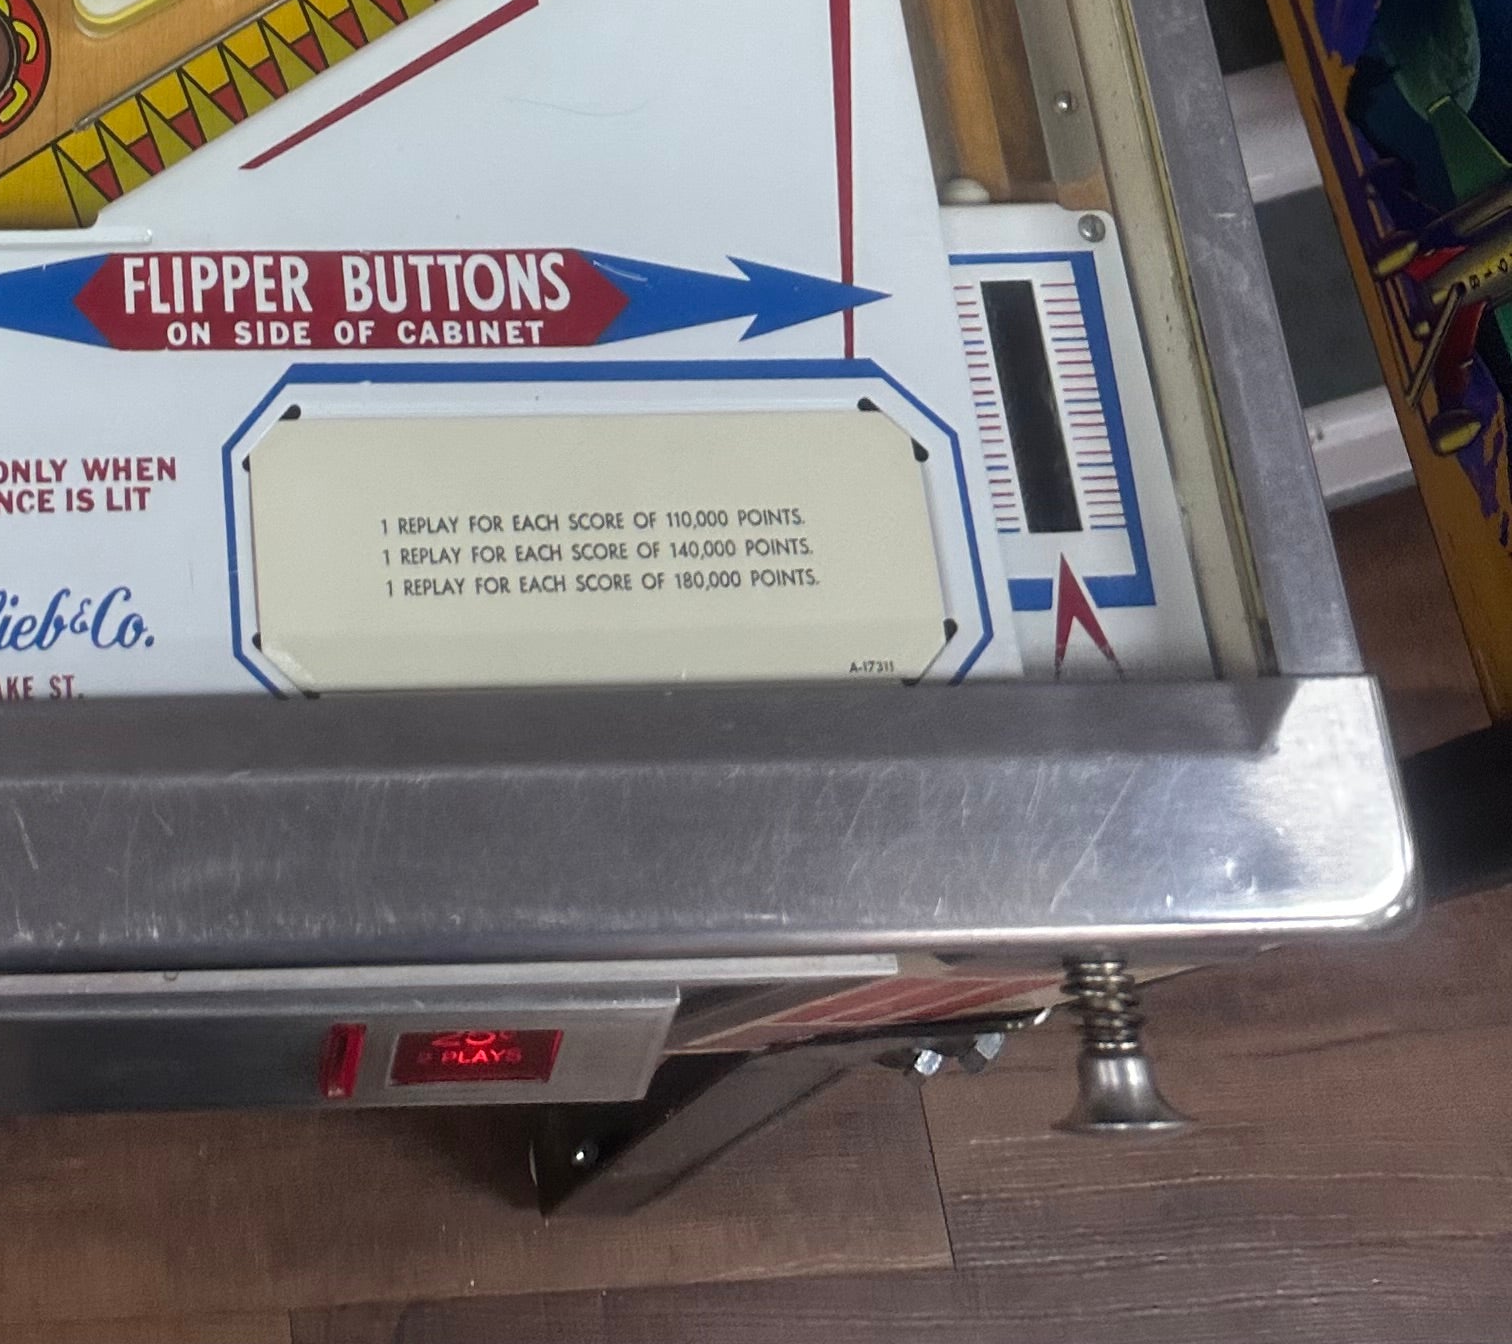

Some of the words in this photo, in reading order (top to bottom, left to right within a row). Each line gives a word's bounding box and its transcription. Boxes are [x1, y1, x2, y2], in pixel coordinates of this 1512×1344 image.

[122, 255, 313, 315] FLIPPER
[342, 252, 572, 312] BUTTONS
[166, 321, 211, 347] ON
[234, 320, 312, 347] SIDE
[334, 320, 376, 346] OF
[397, 319, 545, 346] CABINET
[81, 456, 176, 482] WHEN
[65, 487, 95, 513] IS
[105, 486, 151, 512] LIT
[381, 519, 388, 535] 1
[398, 516, 459, 534] REPLAY
[469, 514, 504, 533] FOR
[512, 513, 560, 531] EACH
[568, 512, 625, 530] SCORE
[633, 512, 656, 529] OF
[665, 509, 729, 530] 110,000
[737, 507, 805, 526] POINTS.
[382, 549, 390, 565] 1
[400, 546, 461, 565] REPLAY
[471, 545, 507, 563] FOR
[515, 544, 563, 562] EACH
[571, 542, 628, 561] SCORE
[636, 541, 660, 559] OF
[669, 539, 736, 560] 140,000
[745, 537, 814, 556] POINTS.
[386, 580, 393, 596] 1
[403, 577, 465, 596] REPLAY
[475, 576, 511, 594] FOR
[519, 575, 567, 593] EACH
[576, 573, 633, 592] SCORE
[641, 572, 665, 590] OF
[674, 569, 742, 591] 180,000
[750, 568, 820, 587] POINTS.
[49, 674, 85, 701] ST.
[440, 1048, 522, 1064] PLAYS
